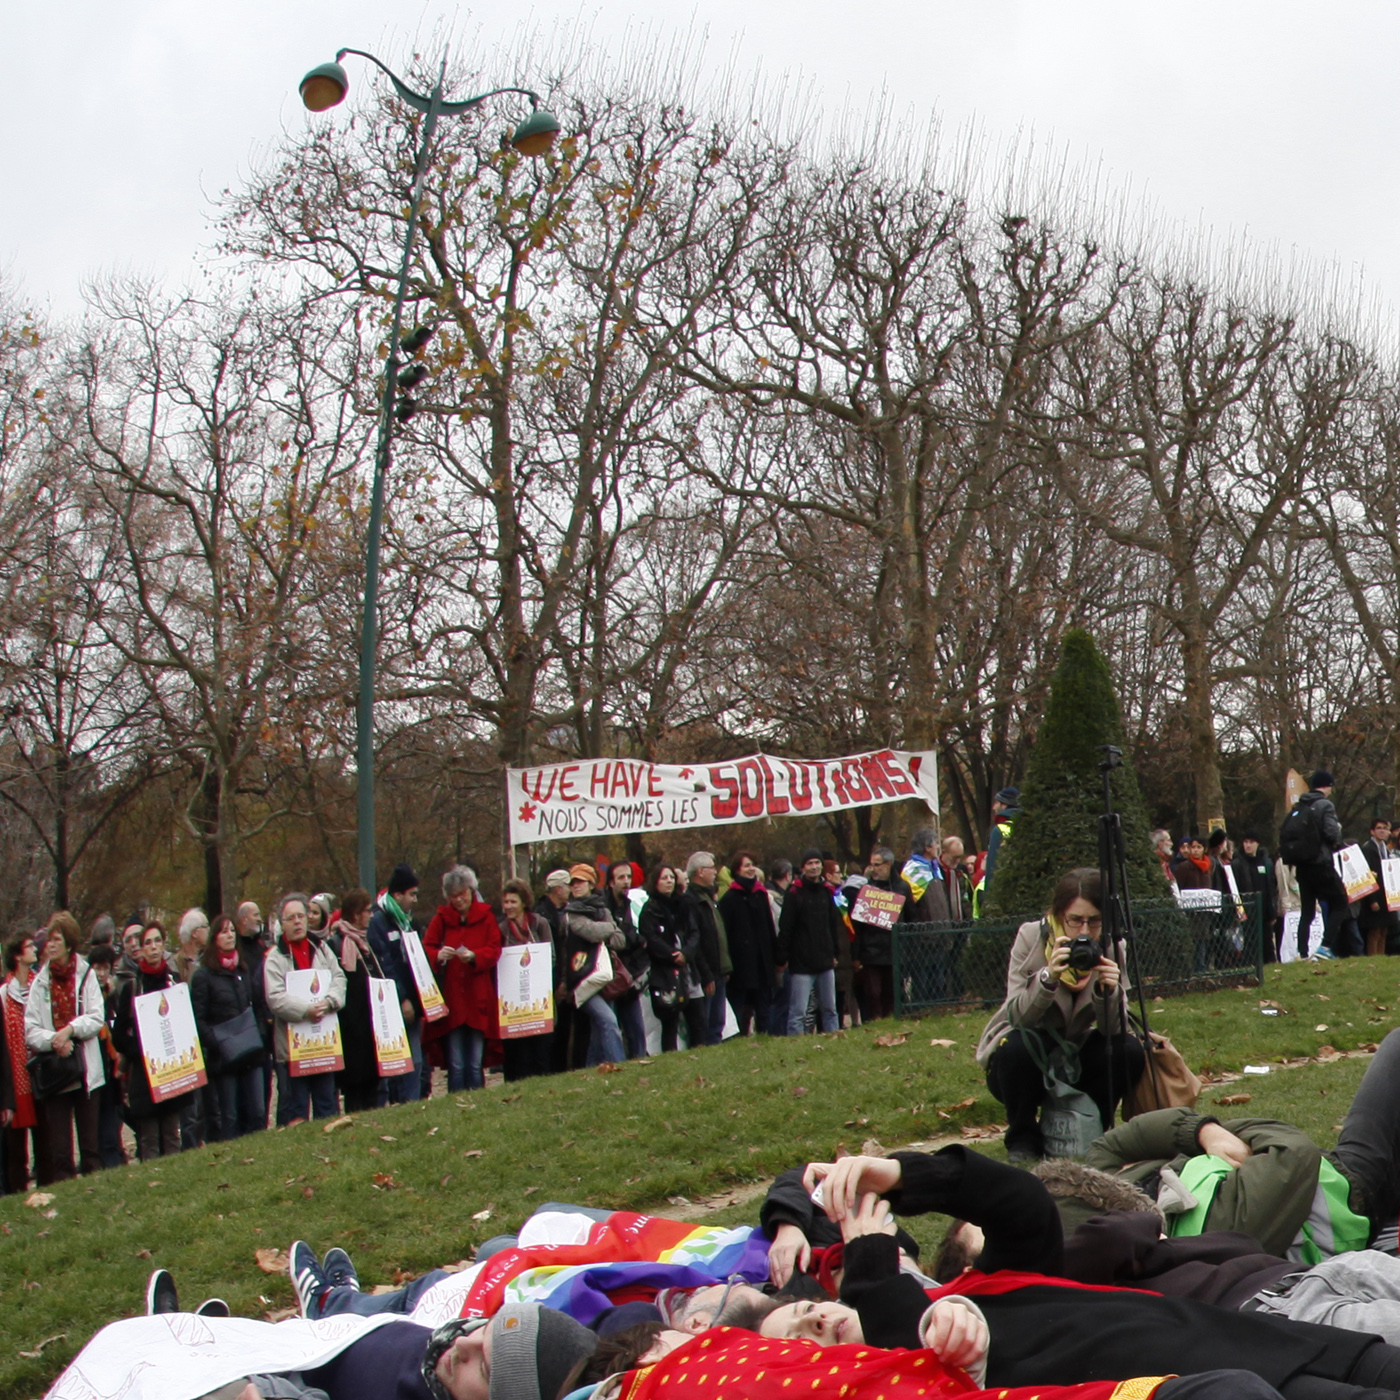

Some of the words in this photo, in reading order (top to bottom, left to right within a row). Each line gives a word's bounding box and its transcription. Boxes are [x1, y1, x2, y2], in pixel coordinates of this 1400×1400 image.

[521, 766, 580, 803] WE
[590, 761, 664, 799] HAVE
[538, 806, 588, 836] NOUS
[597, 801, 664, 832] SOMMES
[671, 797, 698, 824] LES
